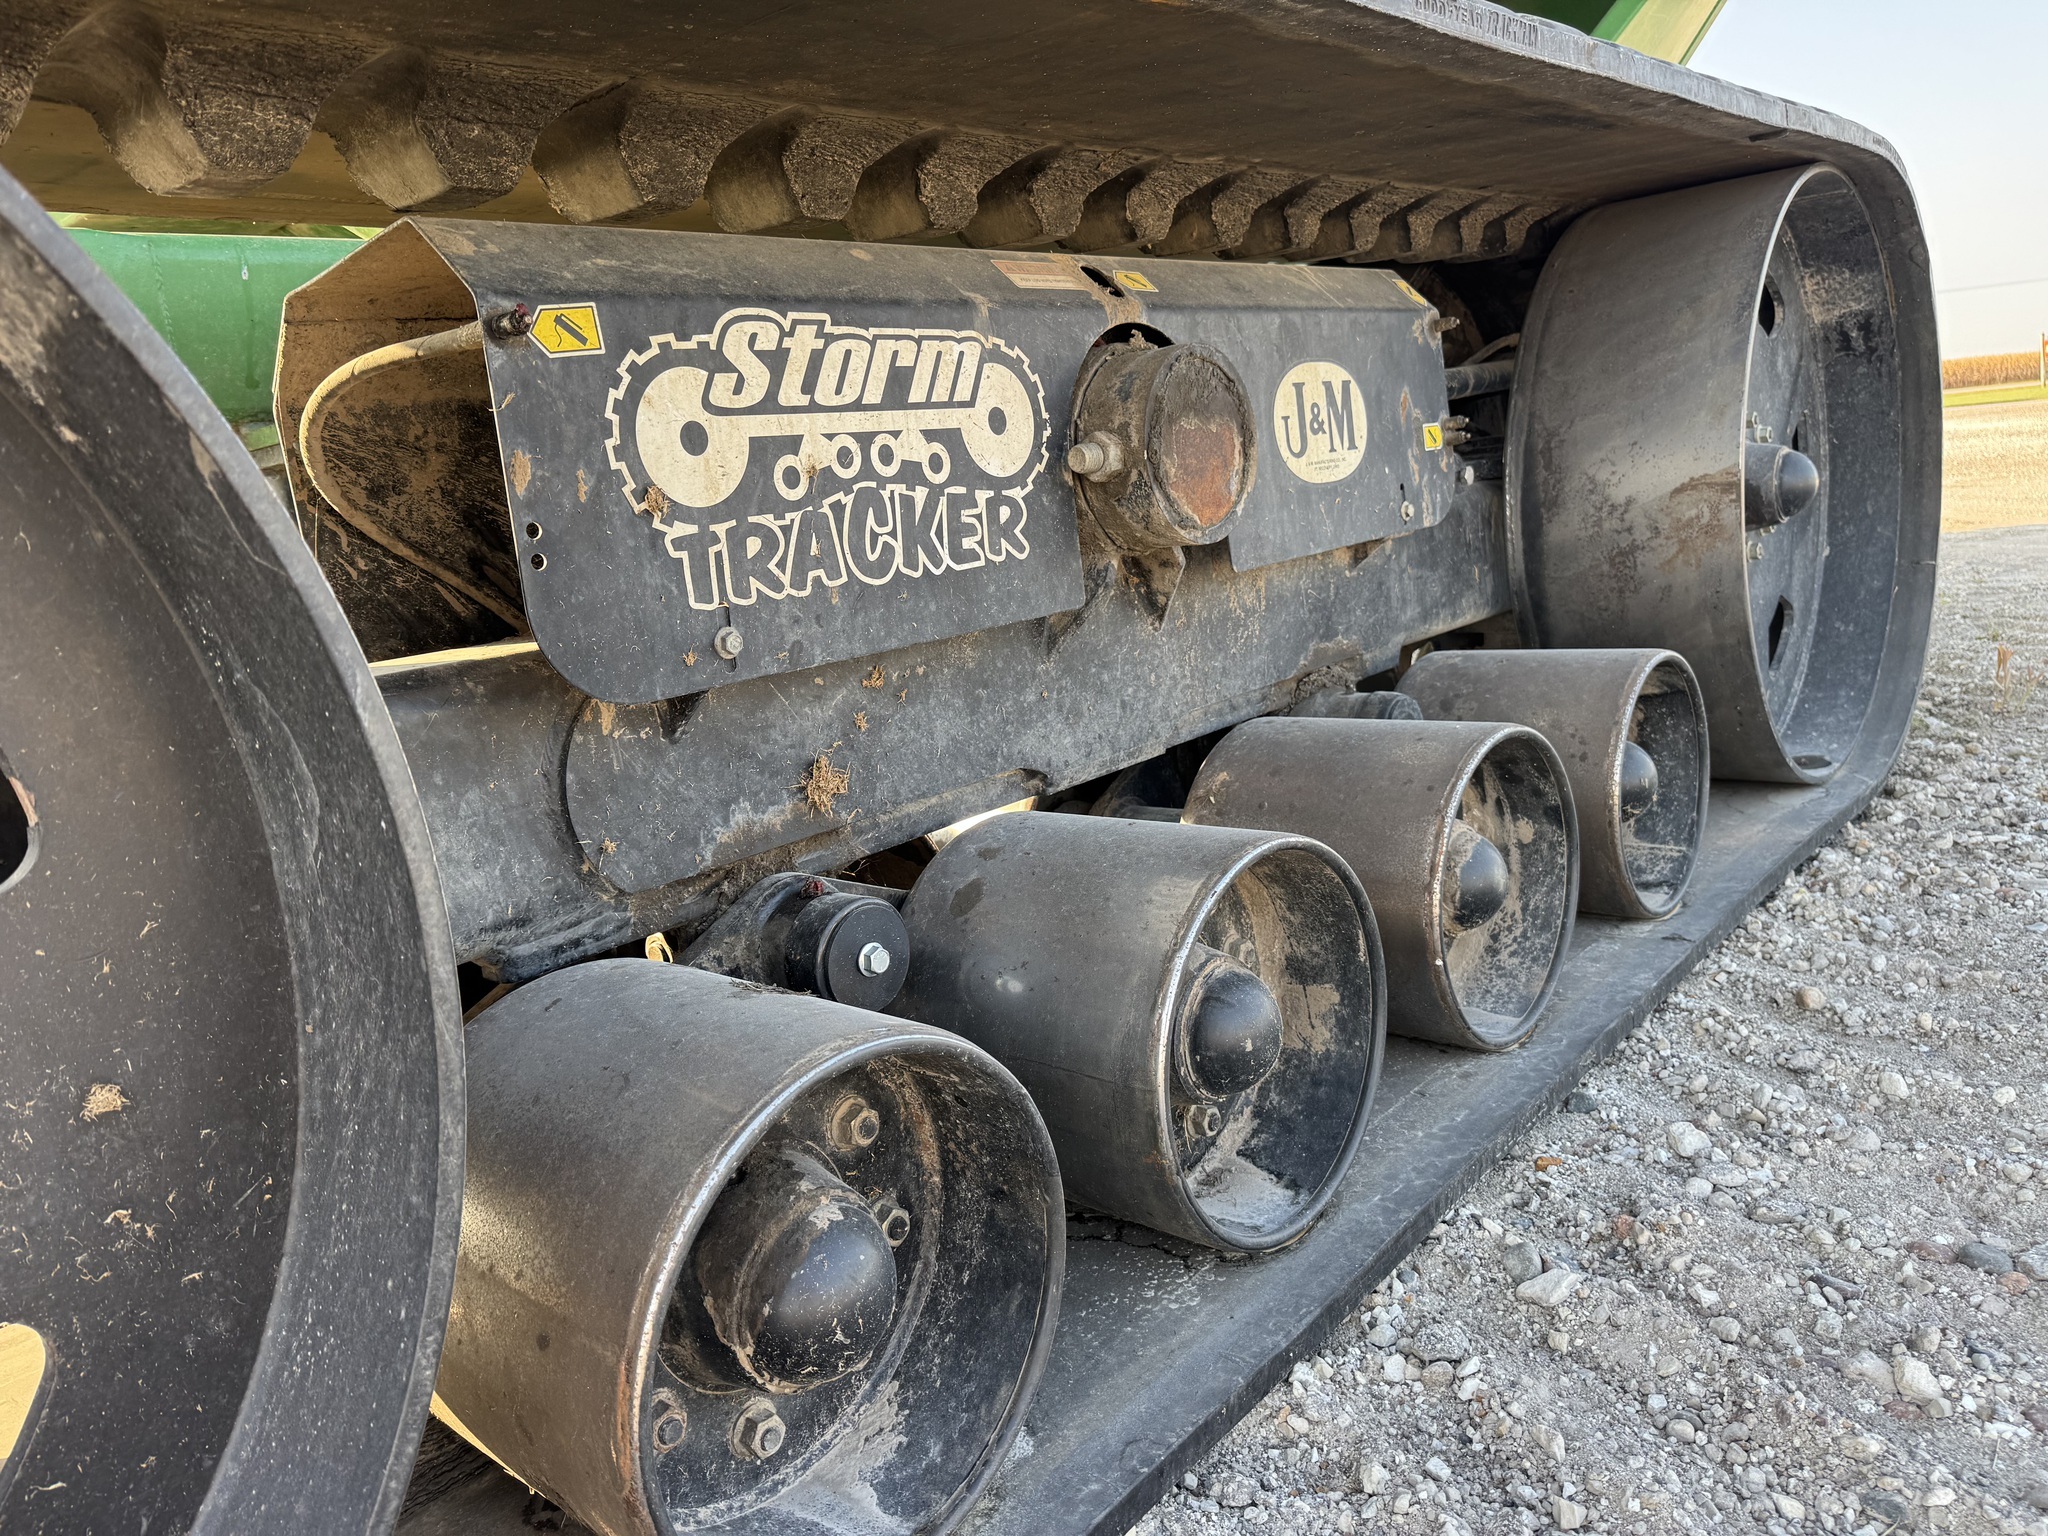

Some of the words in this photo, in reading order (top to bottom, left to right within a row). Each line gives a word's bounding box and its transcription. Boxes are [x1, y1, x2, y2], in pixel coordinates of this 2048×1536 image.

[707, 313, 985, 409] Storm
[1280, 379, 1359, 459] J&M
[665, 482, 1031, 611] TRACKER
